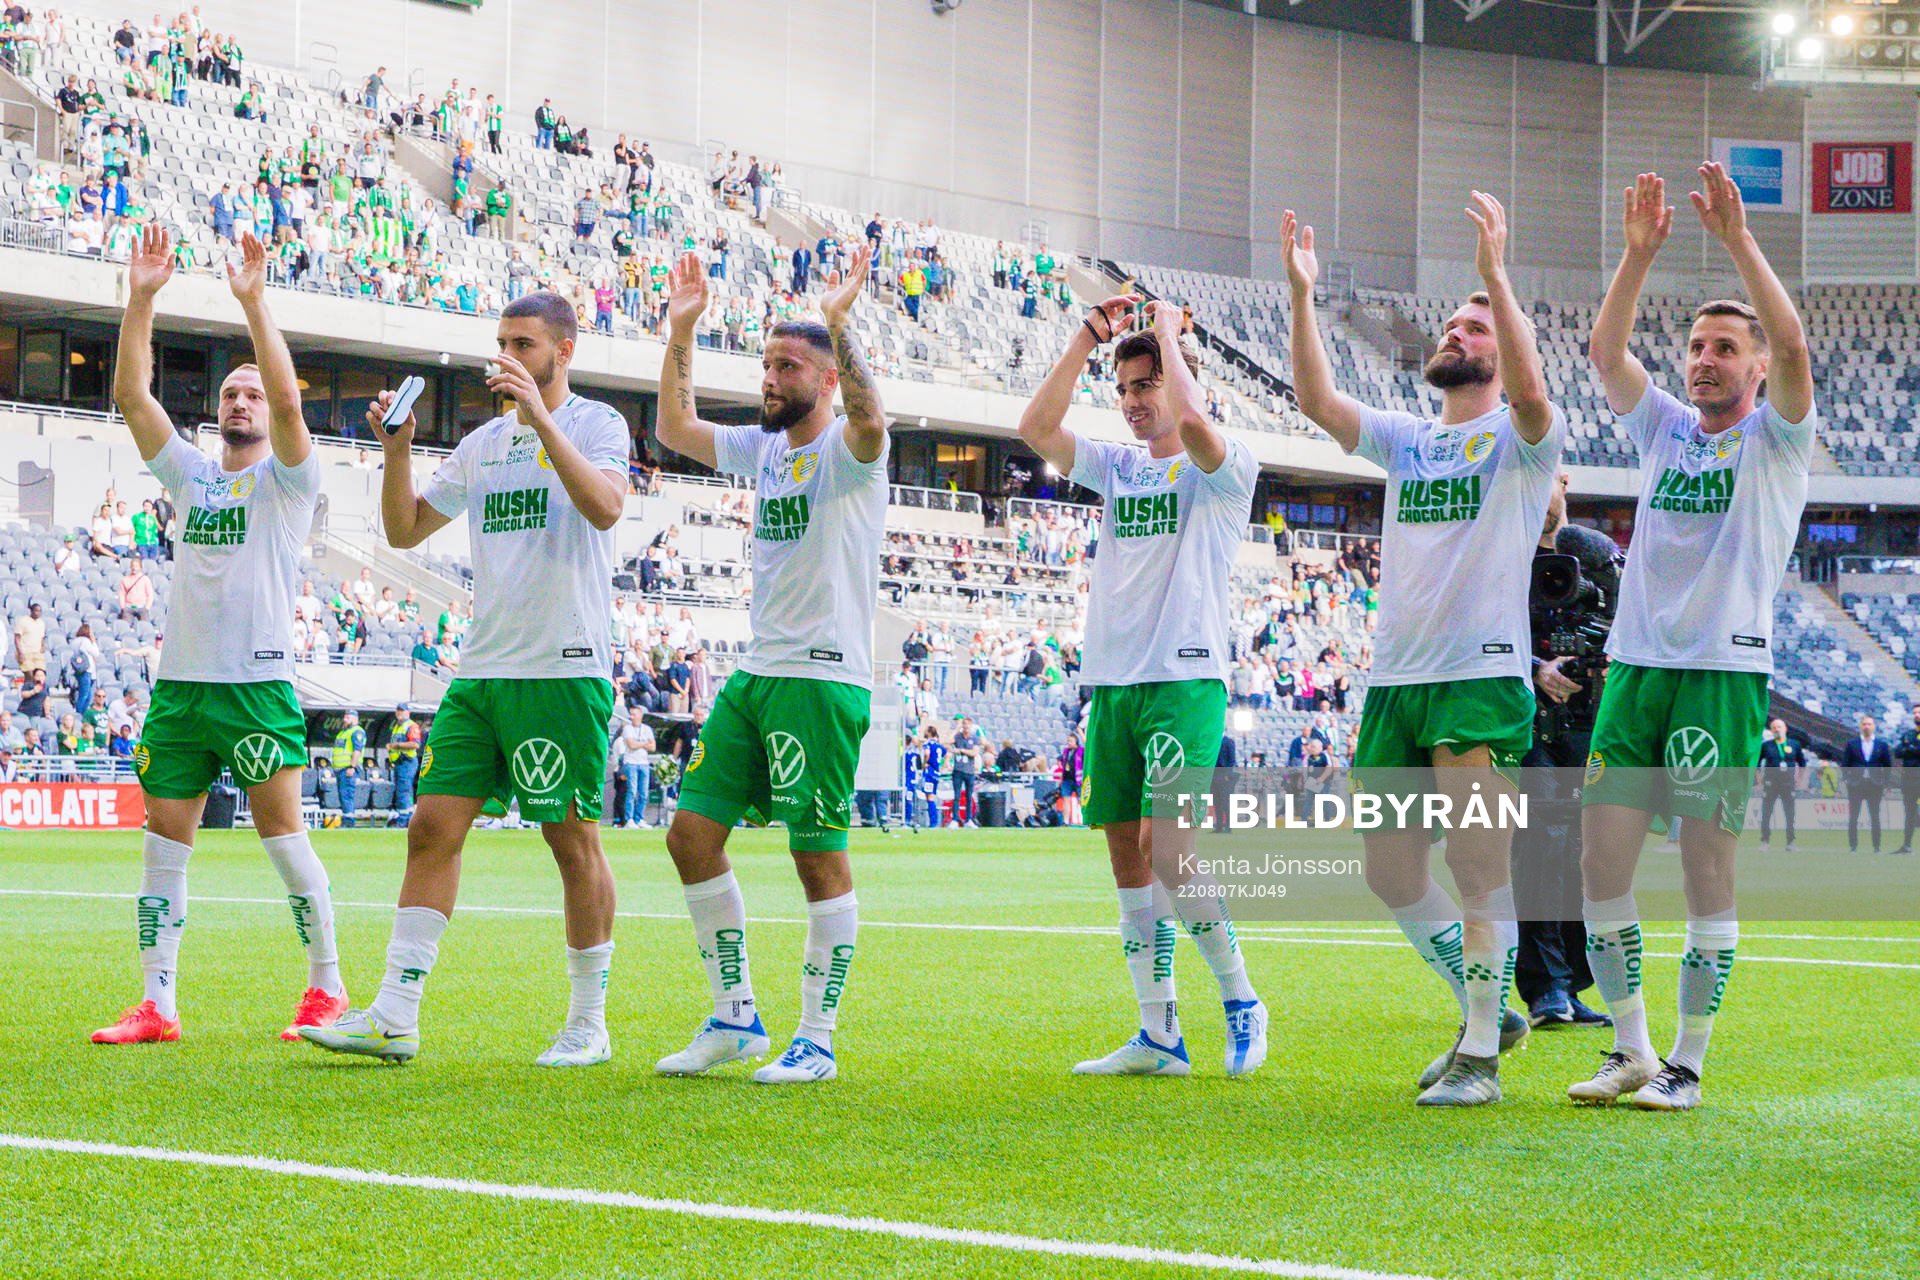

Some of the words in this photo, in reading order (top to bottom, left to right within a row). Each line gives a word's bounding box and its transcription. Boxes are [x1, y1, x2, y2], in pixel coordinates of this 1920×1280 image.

[1834, 152, 1884, 184] JOB
[1830, 189, 1894, 208] ZONE
[1399, 474, 1480, 507] HUSKI
[1655, 467, 1735, 498] HUSKI
[185, 505, 246, 532] HUSKI
[484, 487, 549, 521] HUSKI
[759, 494, 810, 526] USKI
[1113, 492, 1178, 524] USKI
[1397, 505, 1480, 523] CHOCOLATE
[182, 531, 246, 546] CHOCOLATE
[482, 515, 547, 534] CHOCOLATE
[1114, 520, 1178, 539] HOCOLATE
[0, 789, 119, 825] COLATE
[771, 794, 791, 804] RAFT
